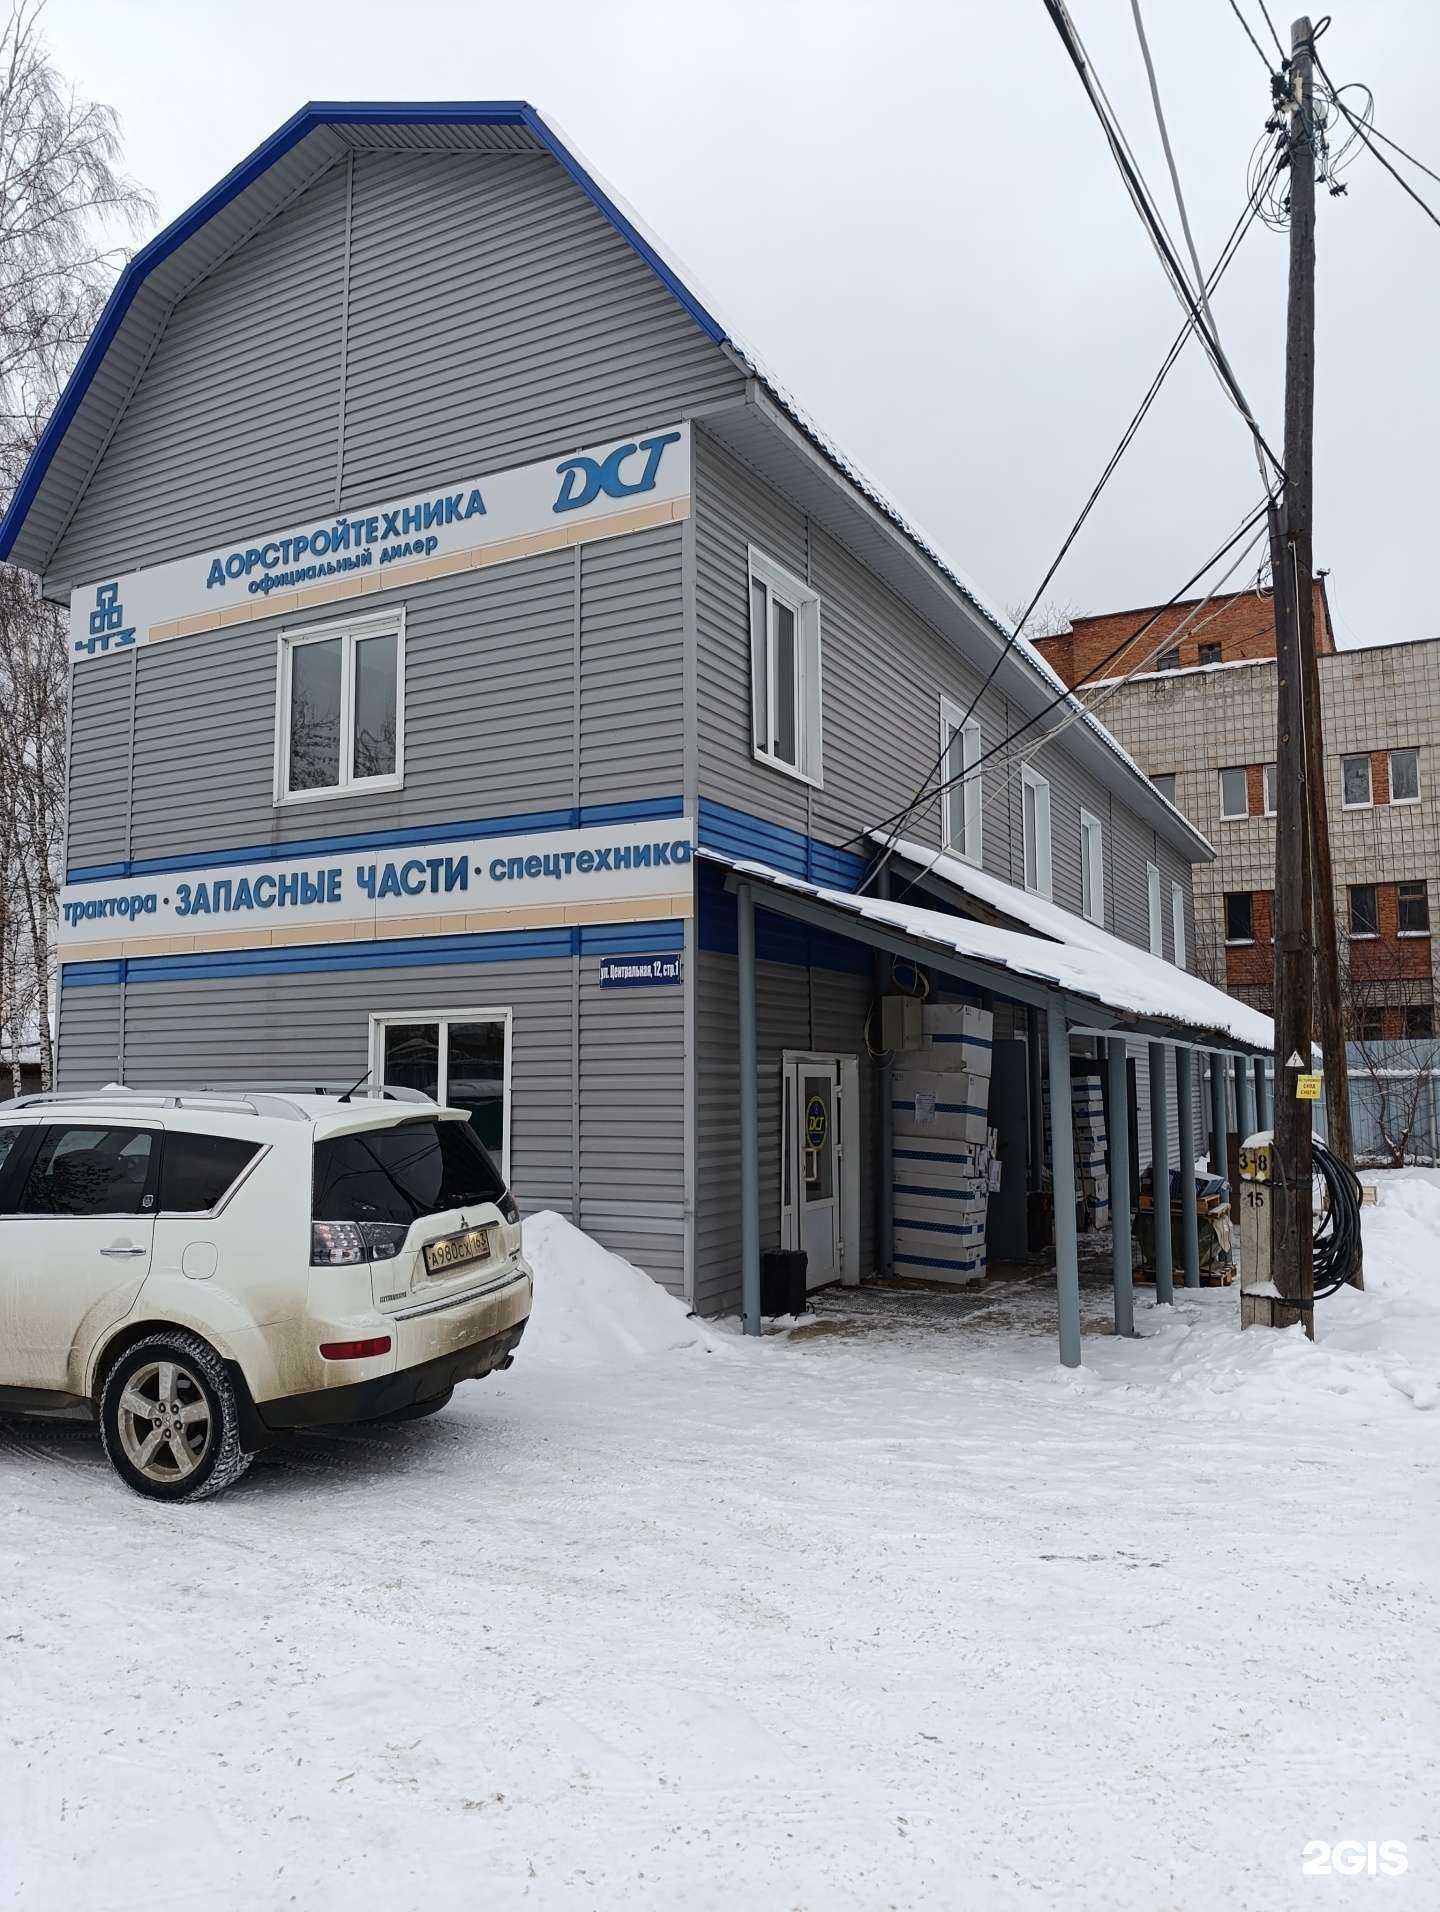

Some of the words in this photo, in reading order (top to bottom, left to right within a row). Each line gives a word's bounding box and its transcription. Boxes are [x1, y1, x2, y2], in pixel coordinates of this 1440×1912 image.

[206, 489, 486, 588] ДОРСТРОЙТЕХНИКА
[248, 546, 372, 594] официальный
[379, 533, 438, 561] дилер
[63, 892, 157, 926] трактора
[175, 868, 342, 915] ЗАПАСНЫЕ
[356, 855, 469, 899] ЧАСТИ
[489, 840, 691, 882] спецтехника
[1247, 1191, 1263, 1207] 15
